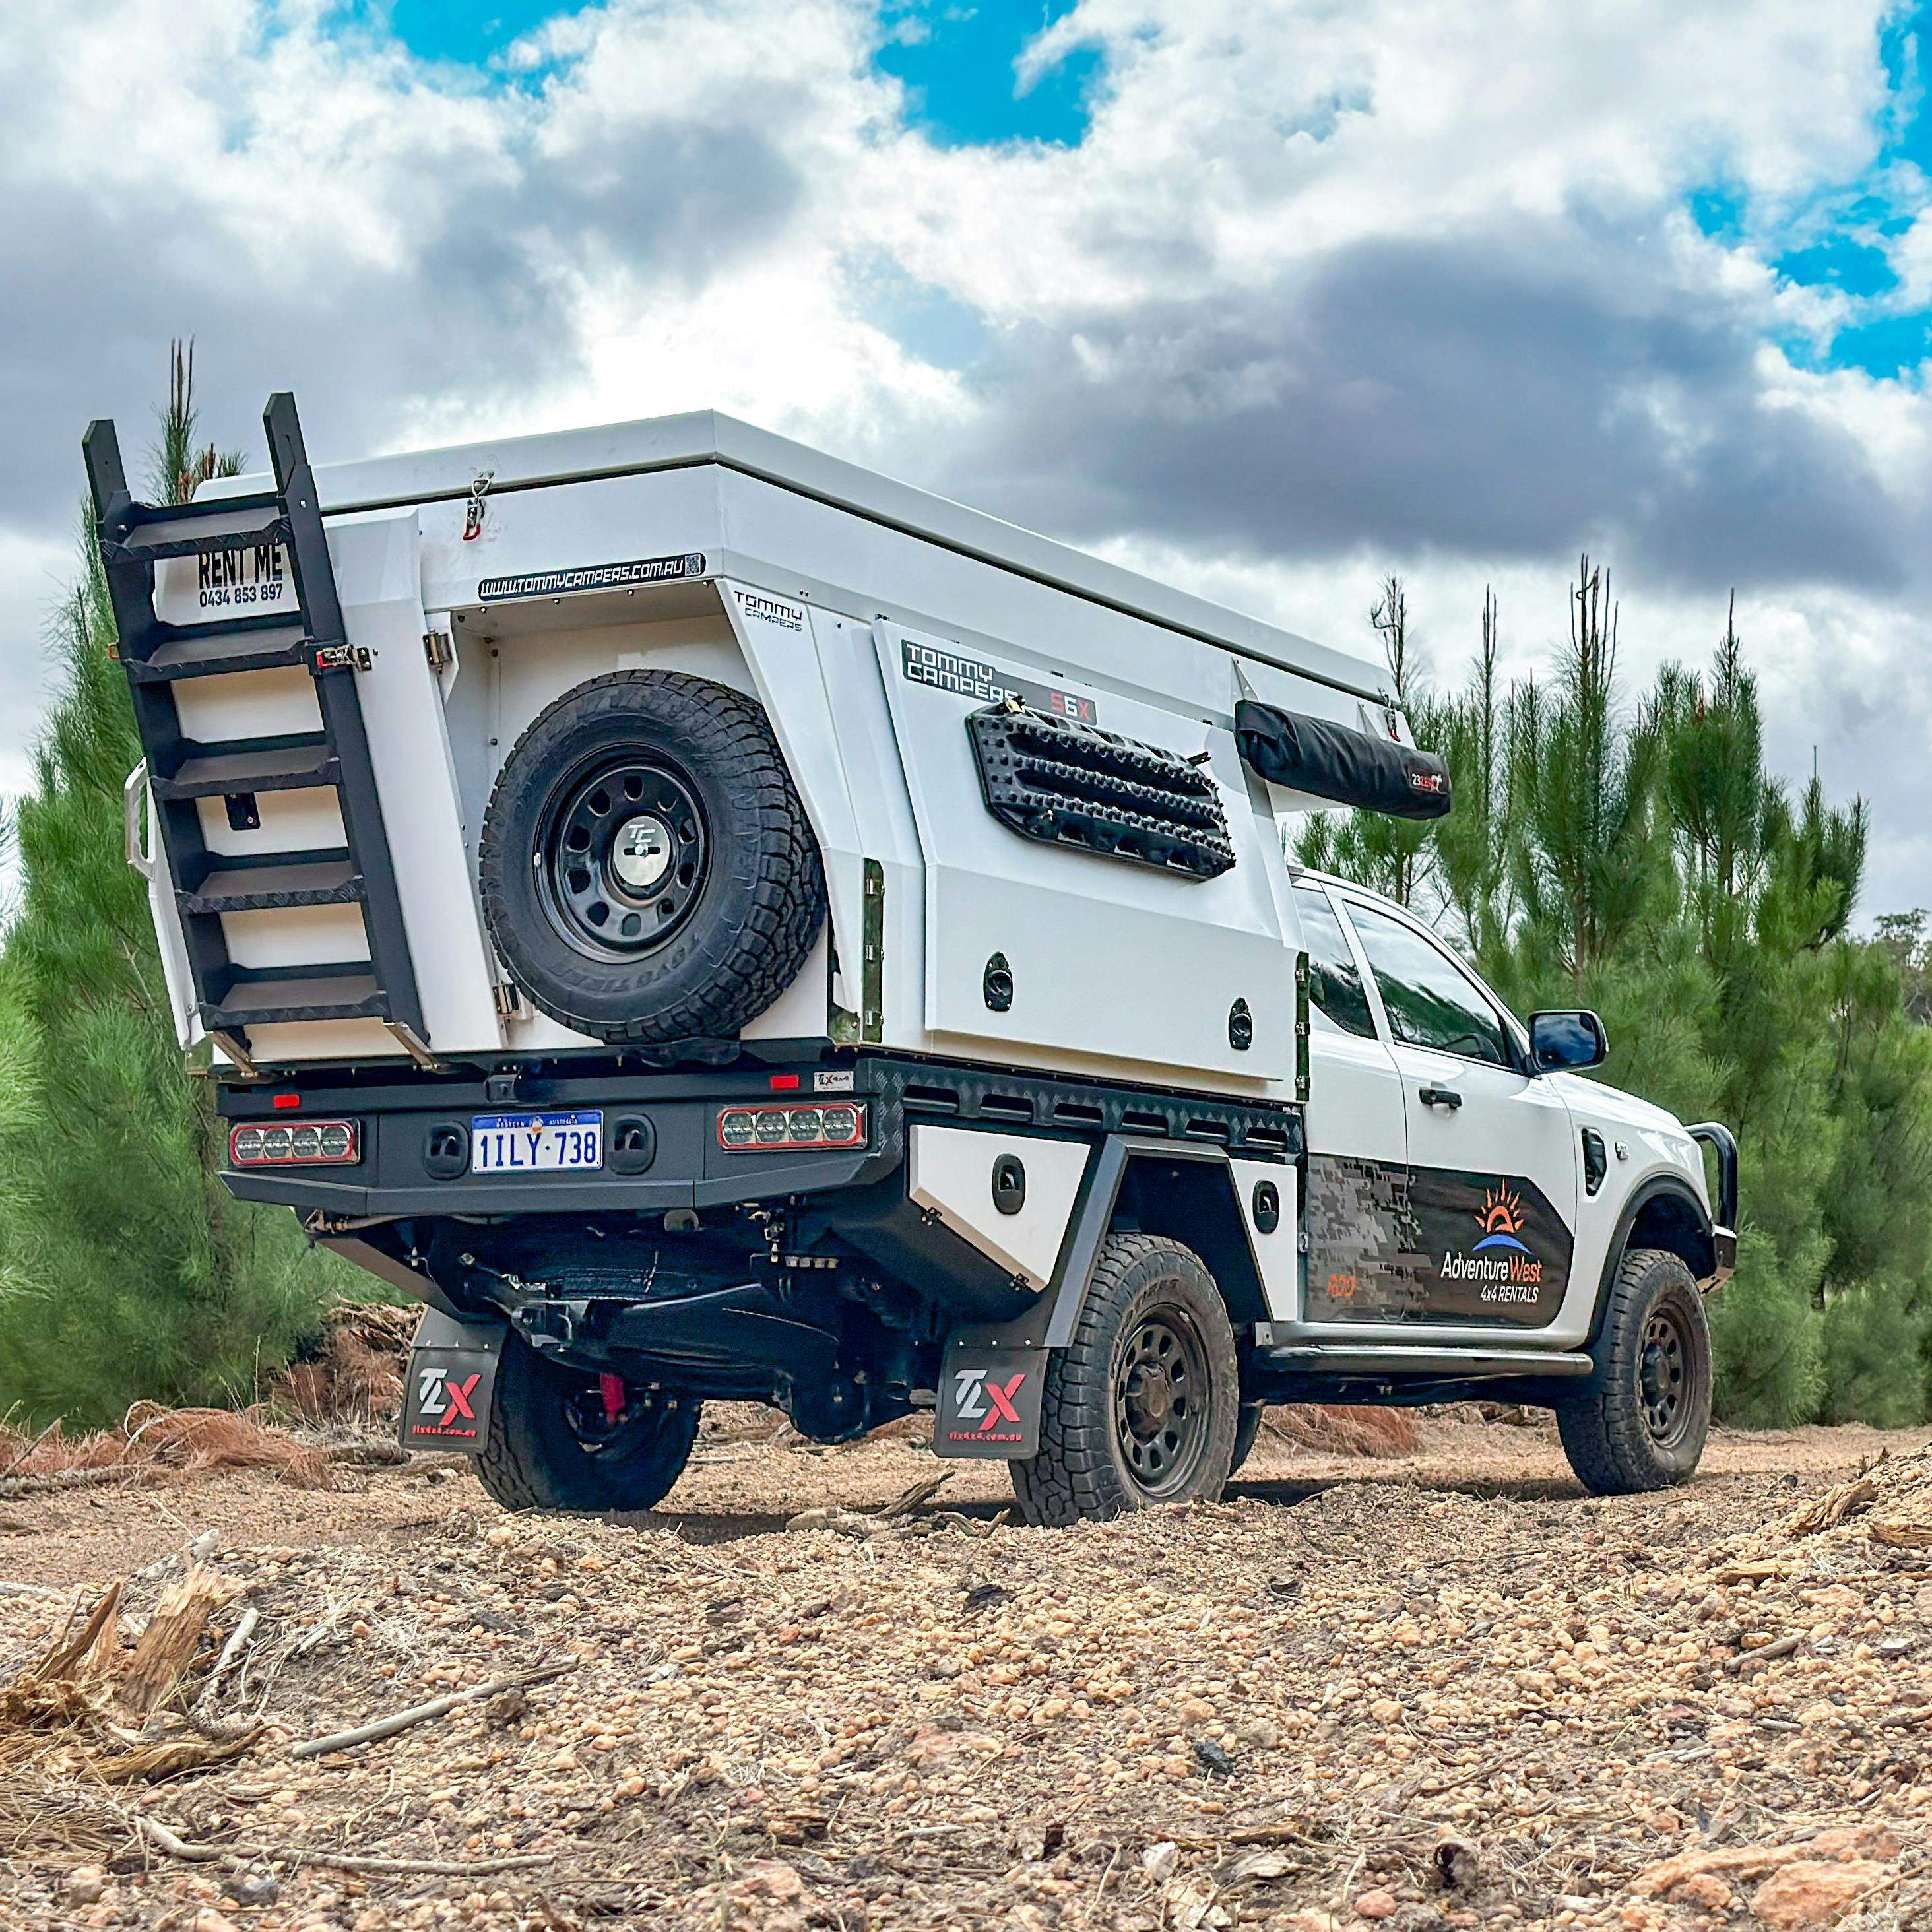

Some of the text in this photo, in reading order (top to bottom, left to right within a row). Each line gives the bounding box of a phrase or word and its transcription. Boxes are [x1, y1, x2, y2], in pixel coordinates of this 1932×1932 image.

[199, 544, 282, 589] RENT ME
[199, 583, 283, 607] 0434 853 897
[734, 591, 802, 620] TOMMY
[745, 608, 802, 632] CAMPERS
[907, 644, 993, 681] TOMMY
[628, 824, 655, 843] TC
[549, 1116, 578, 1126] AUSTRALIA
[1440, 1251, 1543, 1282] AdventureWest
[1480, 1285, 1539, 1303] 4x4 RENTALS
